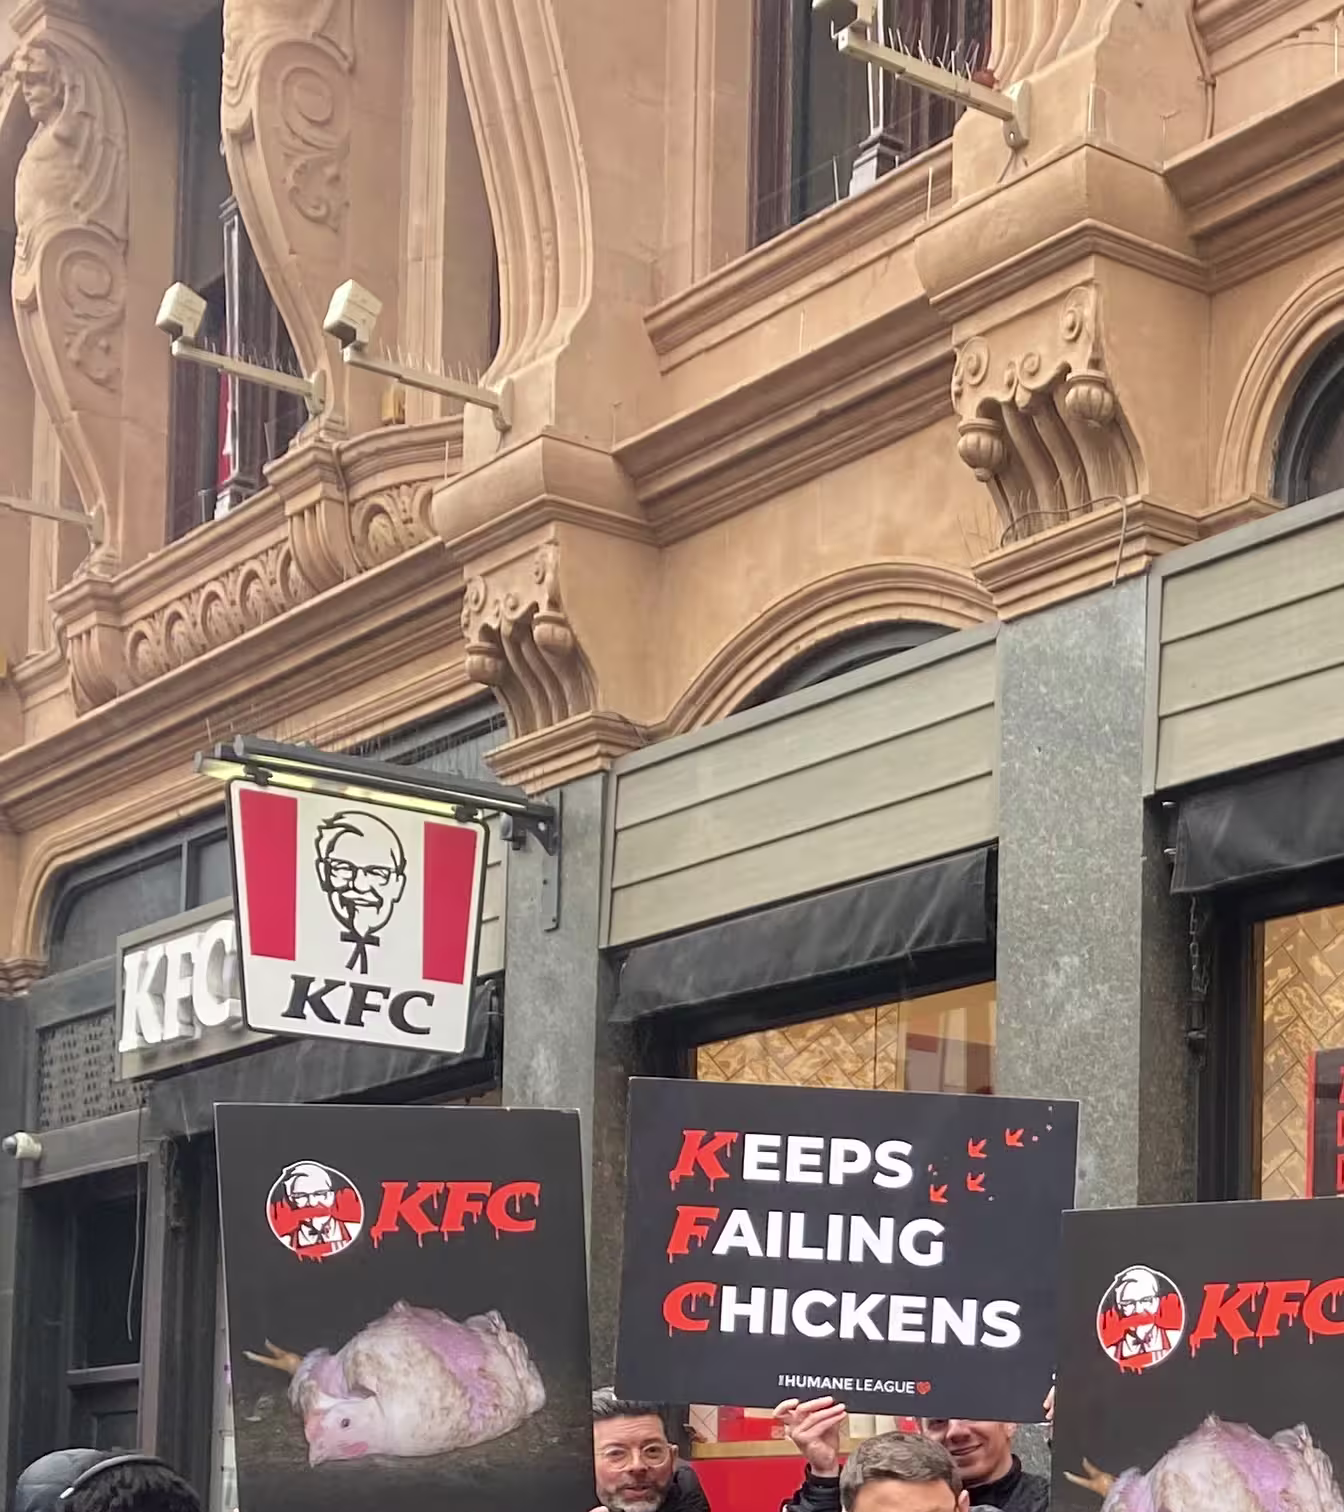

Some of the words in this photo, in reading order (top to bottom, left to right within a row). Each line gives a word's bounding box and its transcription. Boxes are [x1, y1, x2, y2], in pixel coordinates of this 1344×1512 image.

[118, 919, 241, 1052] KFC
[280, 972, 435, 1037] KFC
[670, 1130, 913, 1190] KEEPS
[370, 1182, 540, 1242] KFC
[667, 1206, 944, 1266] FAILING
[663, 1282, 1021, 1348] CHICKENS
[785, 1375, 853, 1390] HUMANE
[856, 1379, 915, 1394] LEAGUE
